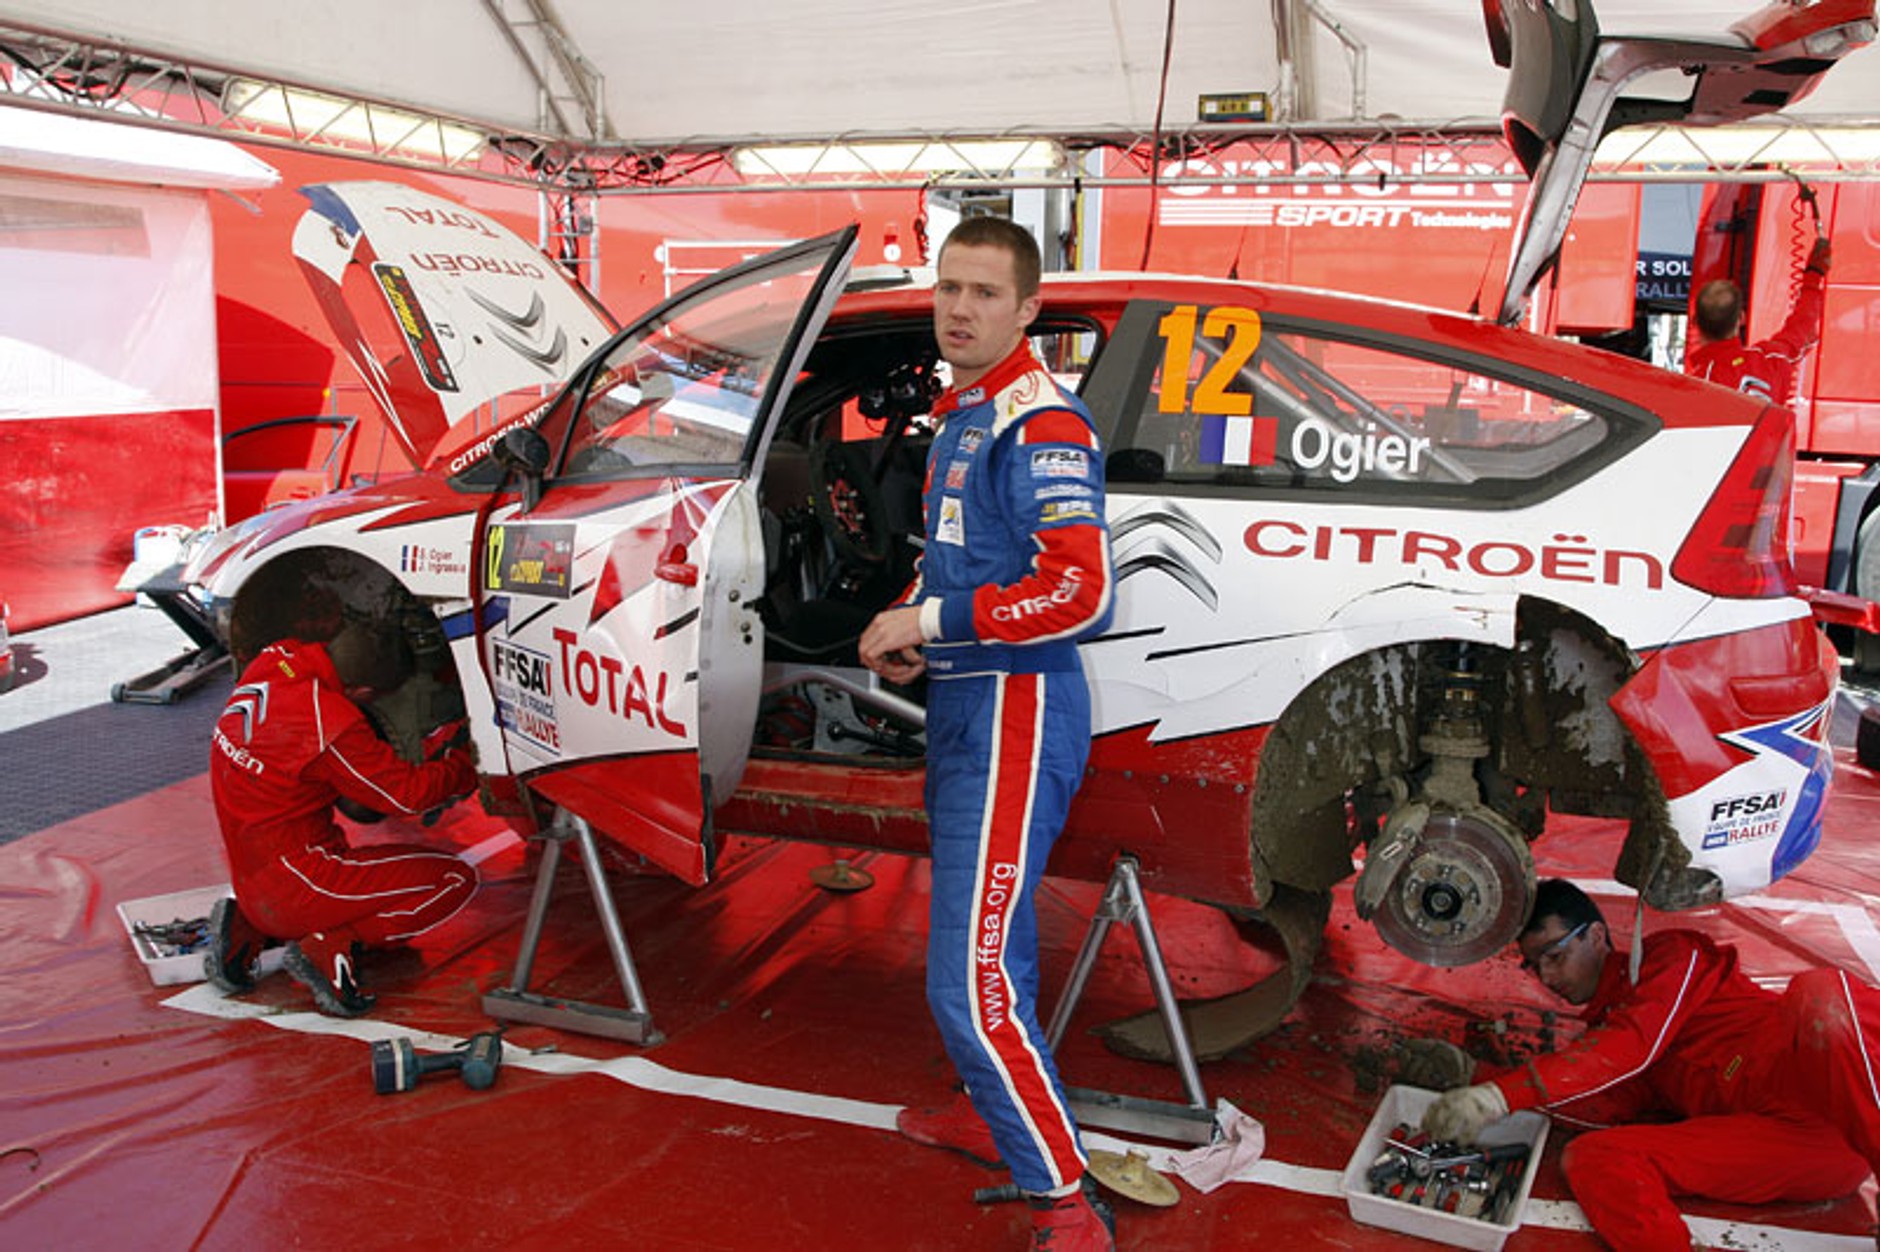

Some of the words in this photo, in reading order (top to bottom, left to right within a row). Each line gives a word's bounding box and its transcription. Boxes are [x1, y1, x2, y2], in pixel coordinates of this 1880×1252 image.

[384, 205, 500, 239] TOTAL
[1276, 205, 1410, 227] SPORT
[1411, 210, 1513, 229] Technologies
[409, 252, 545, 281] CITROËN
[1636, 281, 1690, 298] RALL
[1158, 305, 1262, 415] 12
[1291, 417, 1430, 483] Ogier
[489, 525, 505, 589] 12
[1243, 519, 1663, 590] CITROËN
[494, 643, 546, 696] FFSA
[553, 627, 687, 738] TOTAL
[1711, 793, 1778, 821] FFSA
[1729, 820, 1779, 842] RALLYE
[977, 862, 1018, 1031] www.ffsa.org
